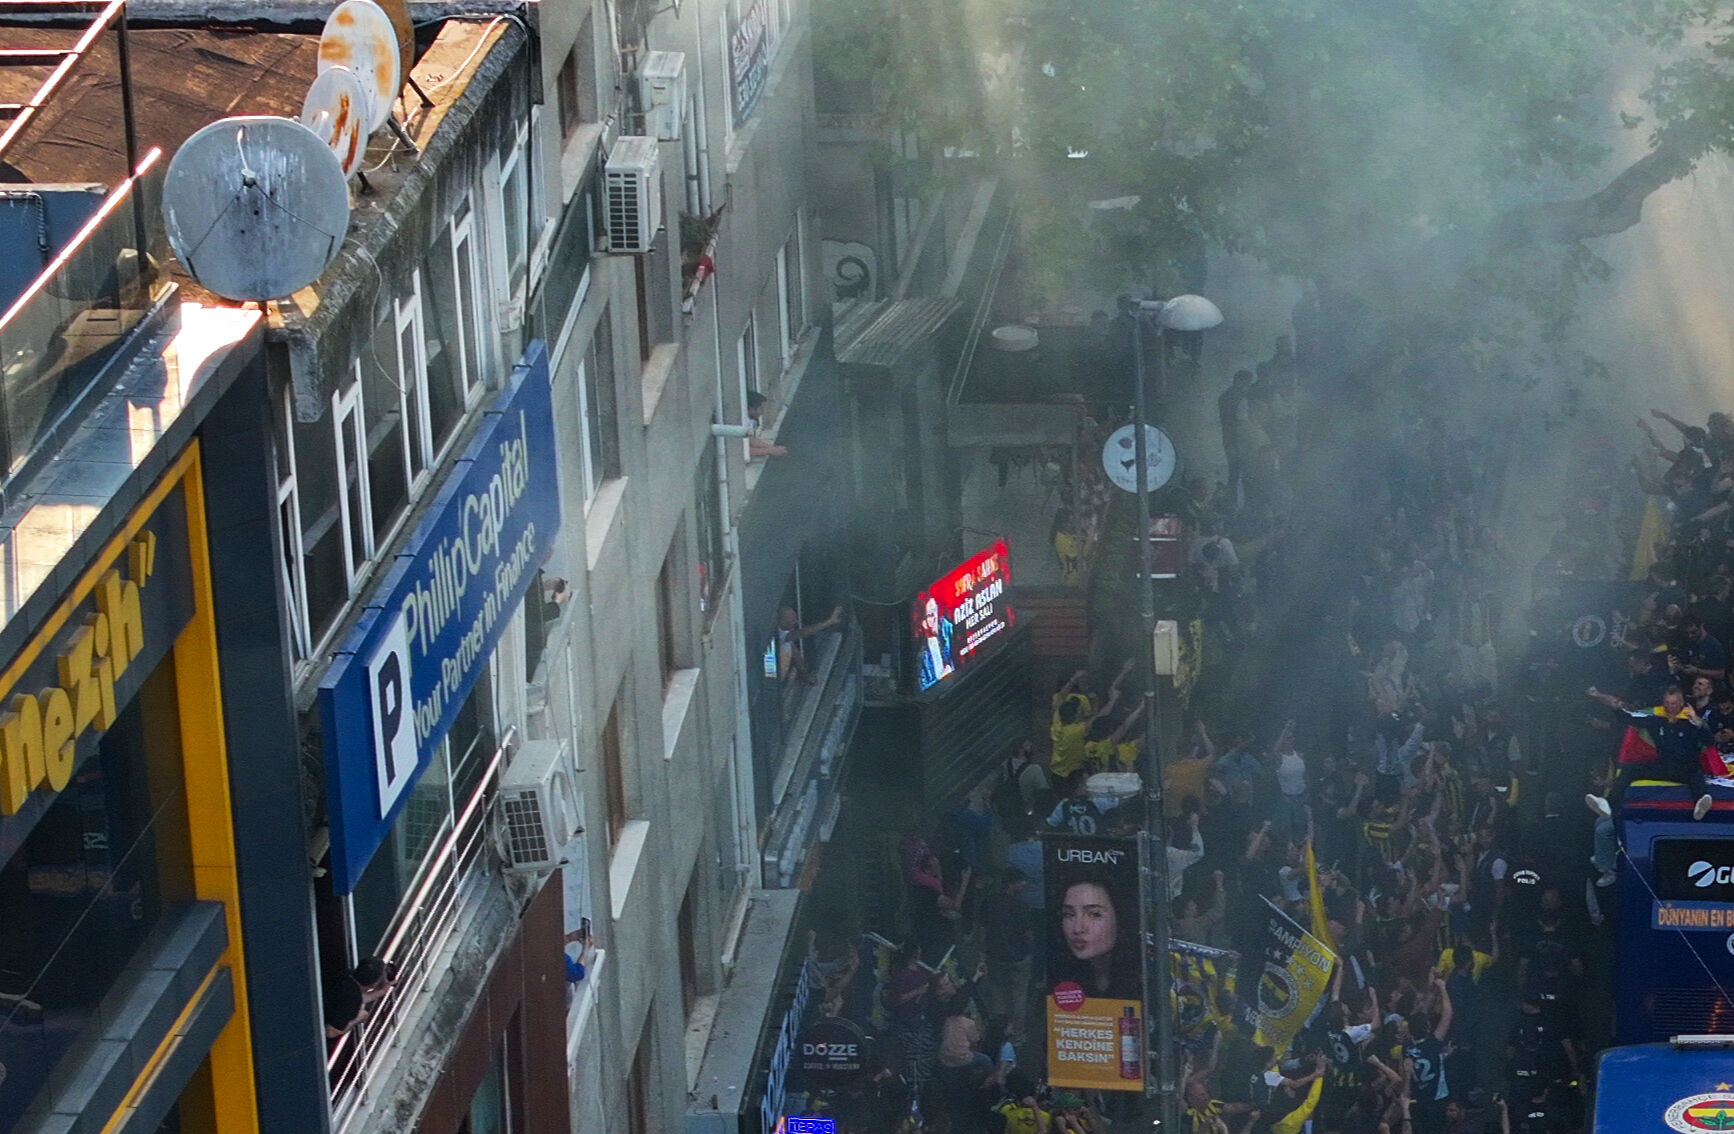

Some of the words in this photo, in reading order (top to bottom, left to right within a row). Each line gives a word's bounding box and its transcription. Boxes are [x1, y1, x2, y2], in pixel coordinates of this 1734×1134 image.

[401, 410, 529, 678] PhillipCapital
[411, 681, 442, 749] Your
[441, 624, 484, 707] Partner
[483, 590, 498, 624] in
[495, 521, 536, 598] Finance
[1057, 849, 1117, 865] URBAN
[1658, 904, 1709, 926] DÜNYANIN
[1711, 909, 1723, 927] EN
